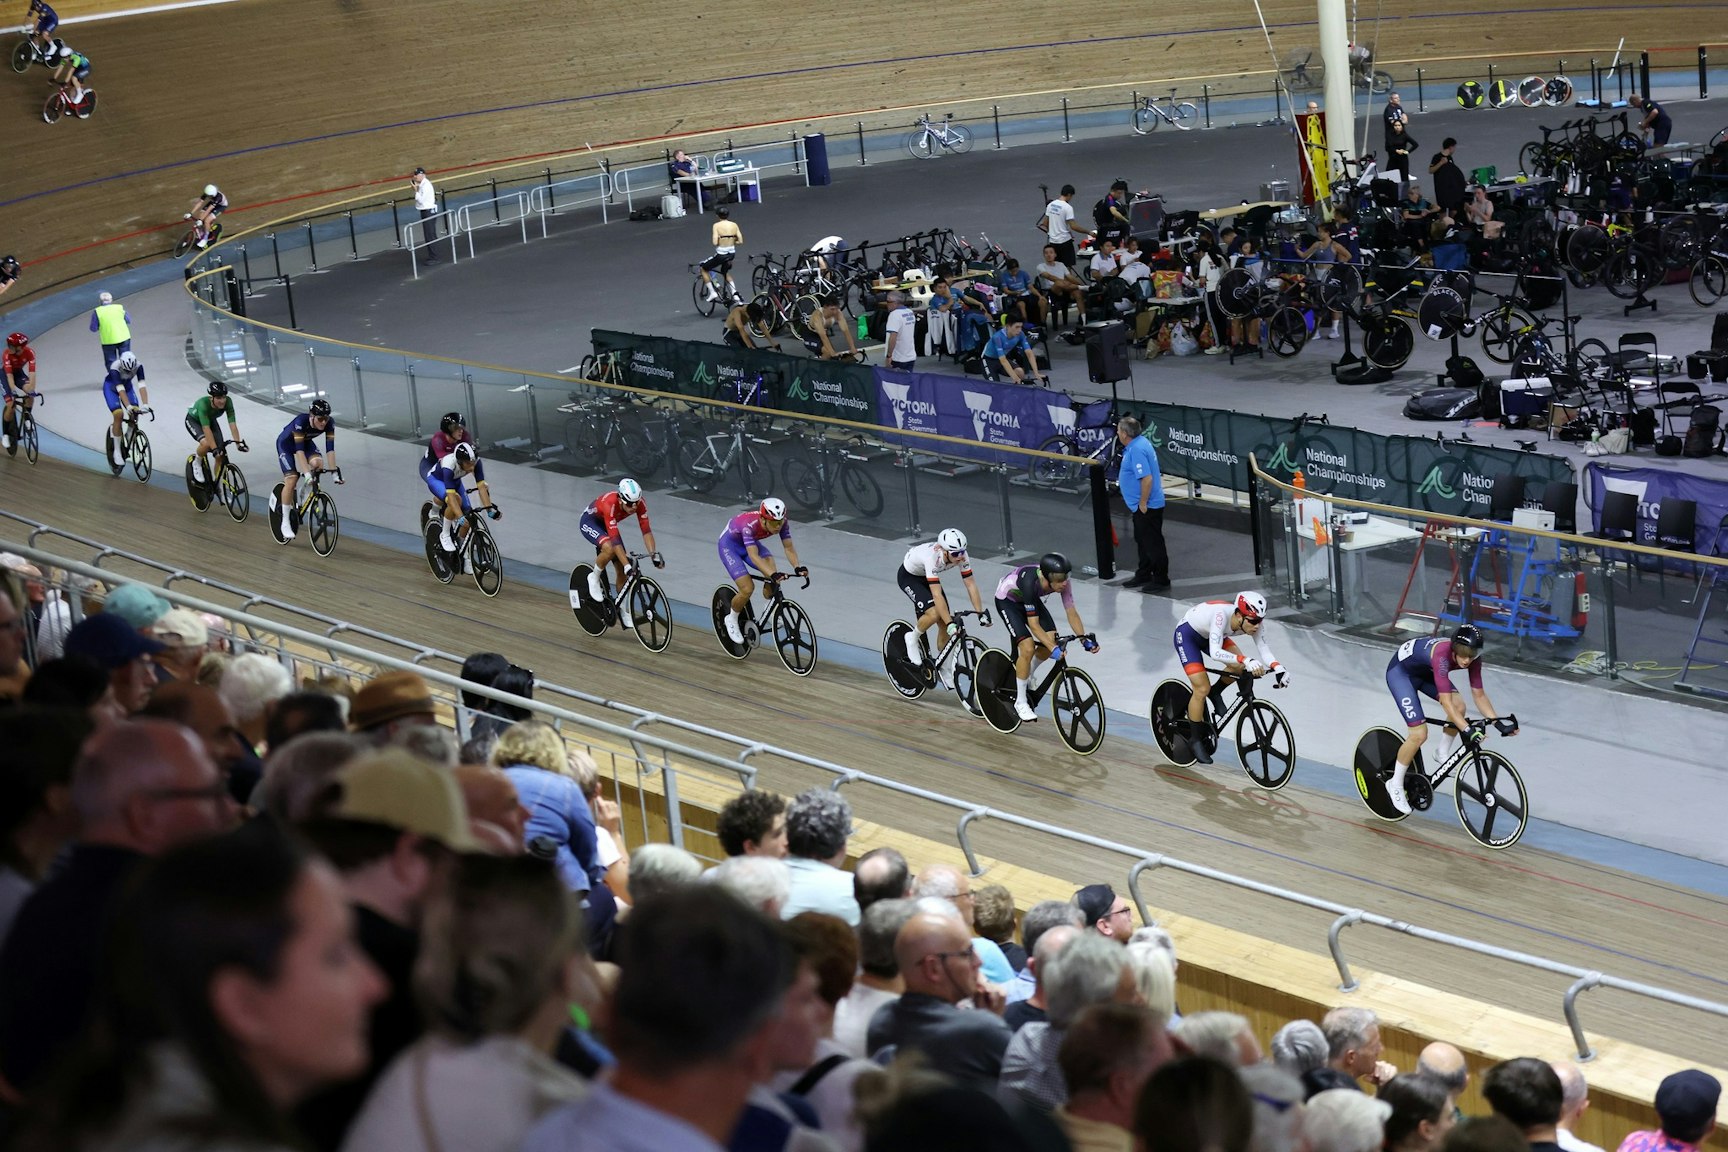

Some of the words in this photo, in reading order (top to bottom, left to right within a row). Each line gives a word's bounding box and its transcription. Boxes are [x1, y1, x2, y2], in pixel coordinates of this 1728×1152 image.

[630, 361, 675, 380] Championships
[812, 379, 843, 393] National
[812, 391, 869, 411] Championships
[890, 397, 937, 416] VICTORIA
[907, 416, 923, 425] State
[970, 407, 1021, 429] VICTORIA
[989, 427, 1005, 437] State
[989, 435, 1021, 447] Government
[1168, 427, 1204, 445] National
[1167, 441, 1239, 466] Championships
[1306, 447, 1347, 467] National
[1306, 462, 1386, 490] Championships
[581, 523, 600, 539] SASI
[1401, 696, 1417, 719] QAS
[1431, 753, 1459, 784] ARGON
